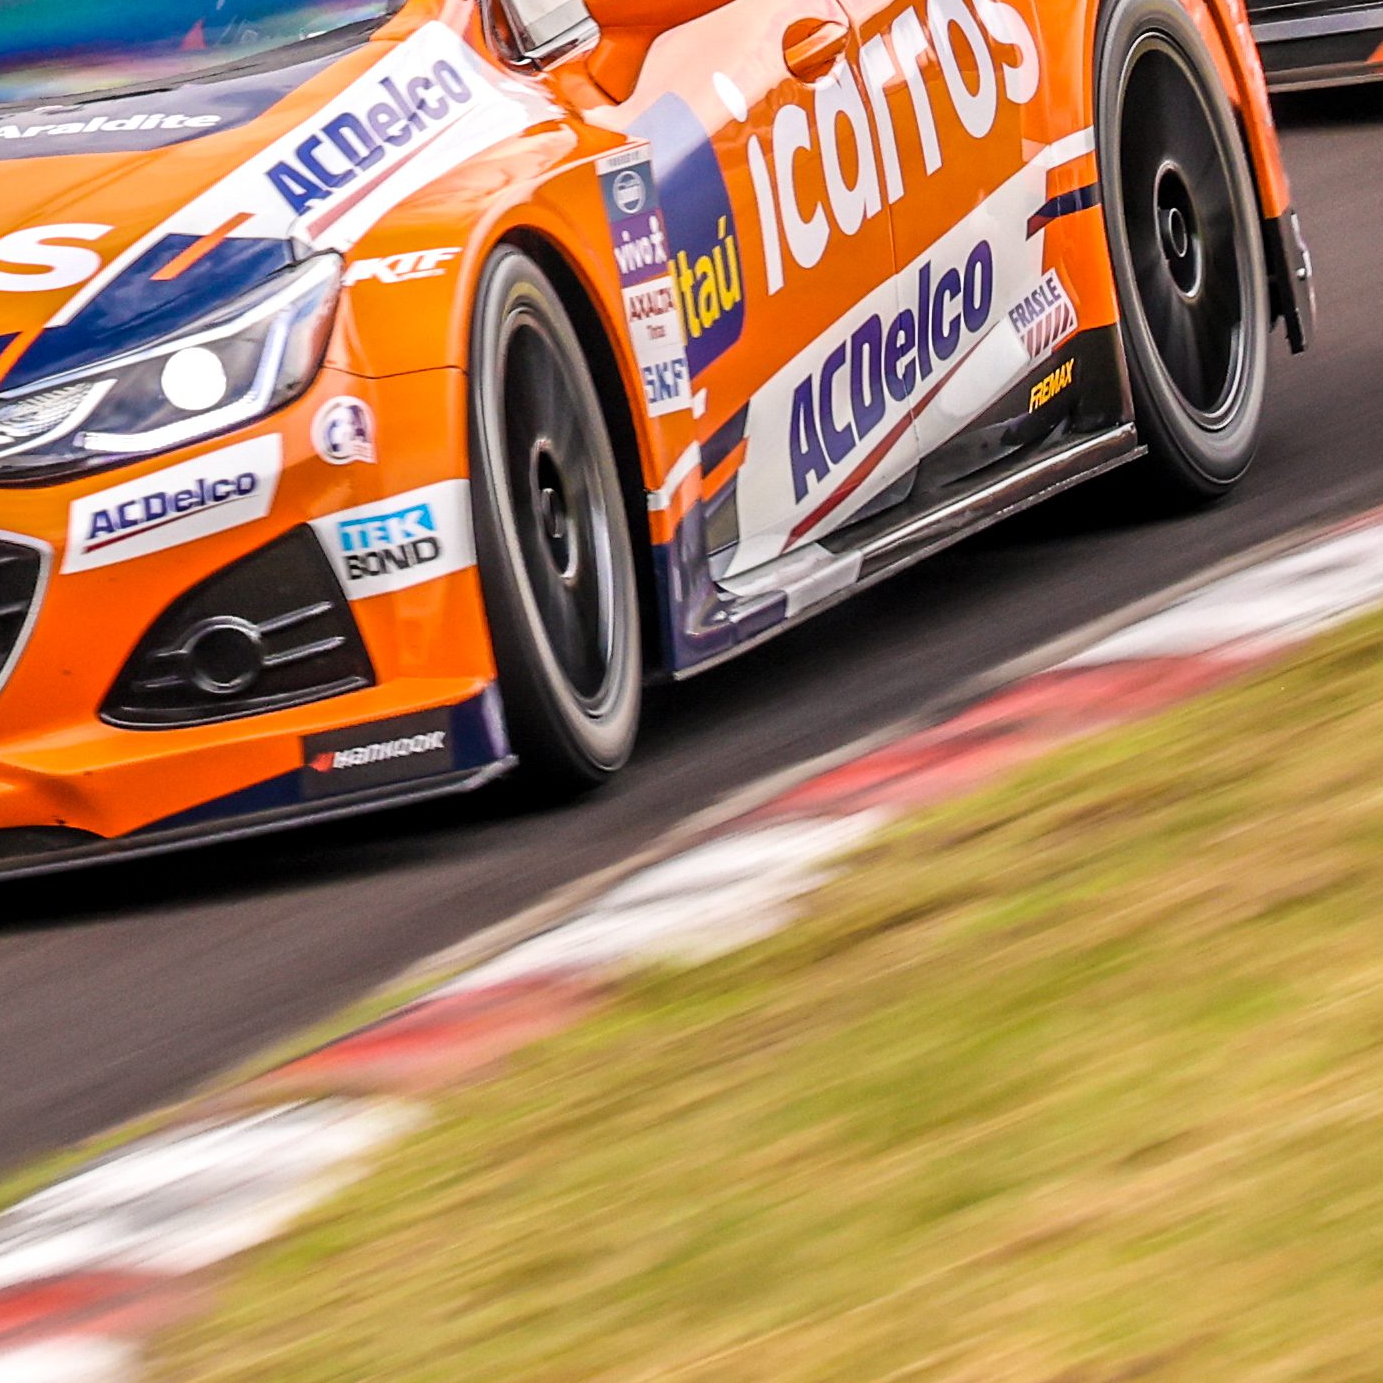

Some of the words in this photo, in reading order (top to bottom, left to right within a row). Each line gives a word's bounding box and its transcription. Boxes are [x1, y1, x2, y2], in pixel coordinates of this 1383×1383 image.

[265, 59, 473, 217] ACDelco
[669, 215, 743, 348] Itaú
[643, 357, 688, 404] SKF
[788, 239, 993, 505] ACDelco
[1028, 357, 1075, 415] FREMAX
[86, 469, 259, 541] ACDelco
[344, 535, 442, 581] BOND
